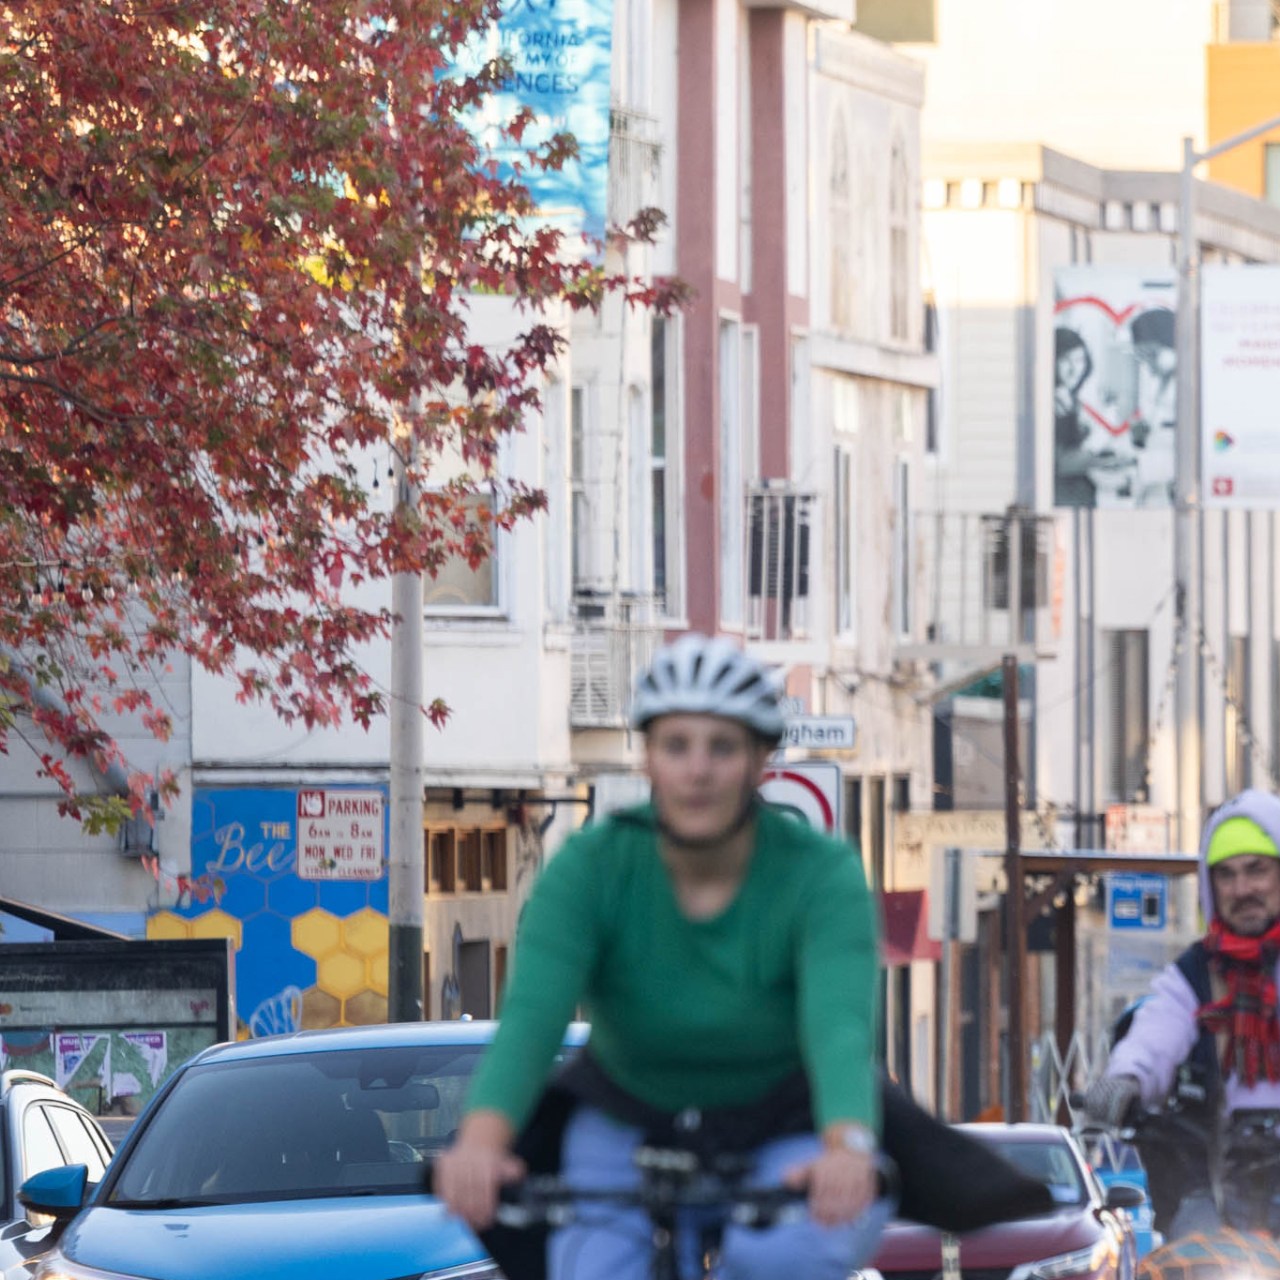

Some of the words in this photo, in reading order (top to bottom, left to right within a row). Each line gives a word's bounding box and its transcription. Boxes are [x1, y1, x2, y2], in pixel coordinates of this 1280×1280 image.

[328, 800, 379, 816] PARKING
[260, 821, 291, 840] THE
[305, 846, 325, 860] MON
[333, 846, 353, 860] WED
[360, 846, 376, 860] FRI
